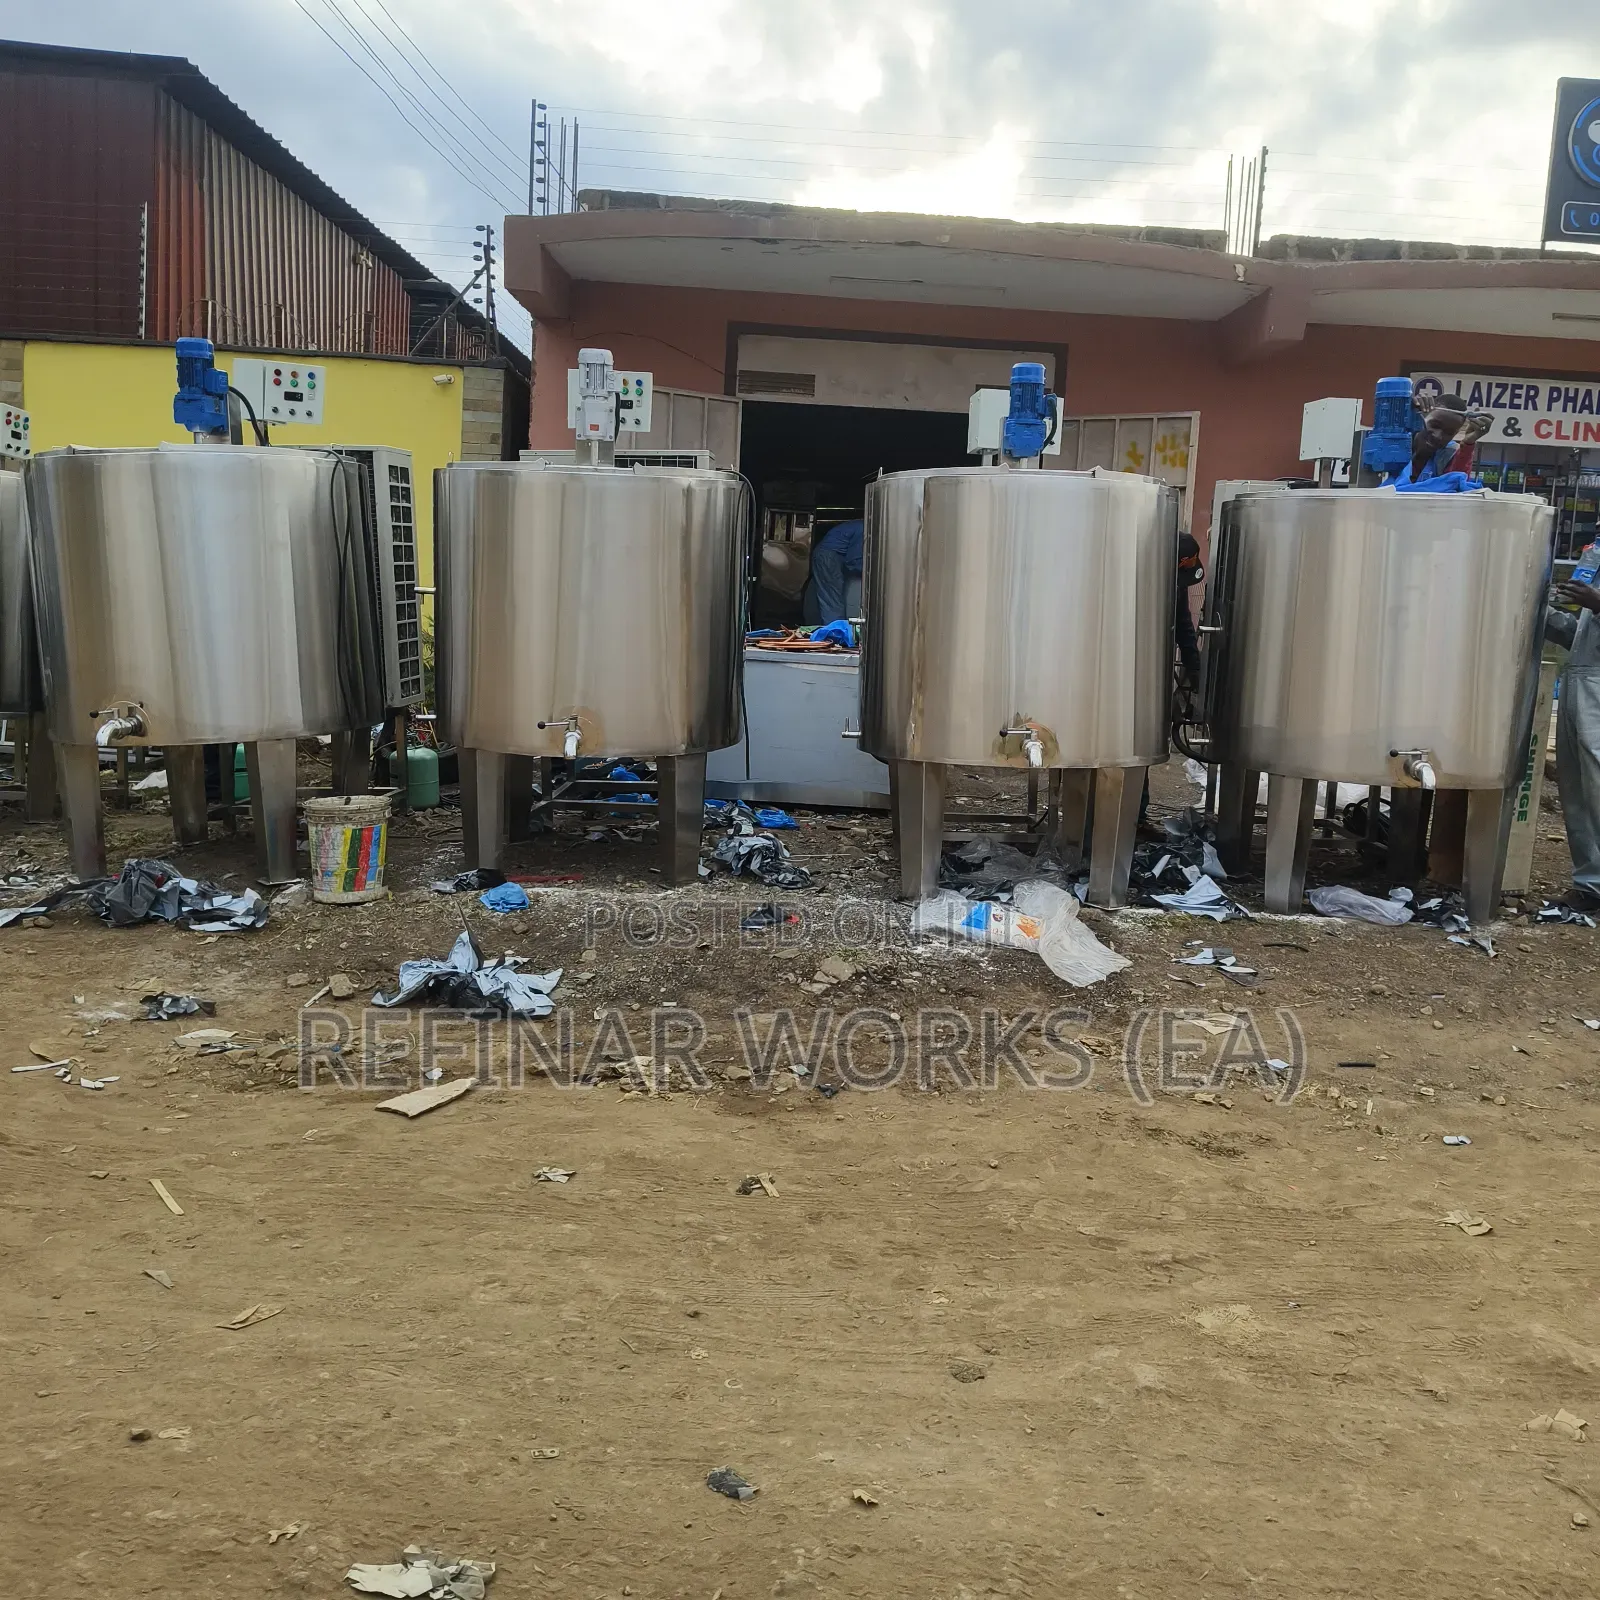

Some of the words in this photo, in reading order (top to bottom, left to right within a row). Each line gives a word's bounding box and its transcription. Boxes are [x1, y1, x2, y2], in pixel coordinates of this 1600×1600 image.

[1455, 380, 1540, 411] LAIZER
[1547, 386, 1600, 415] PHA
[1502, 417, 1523, 437] &
